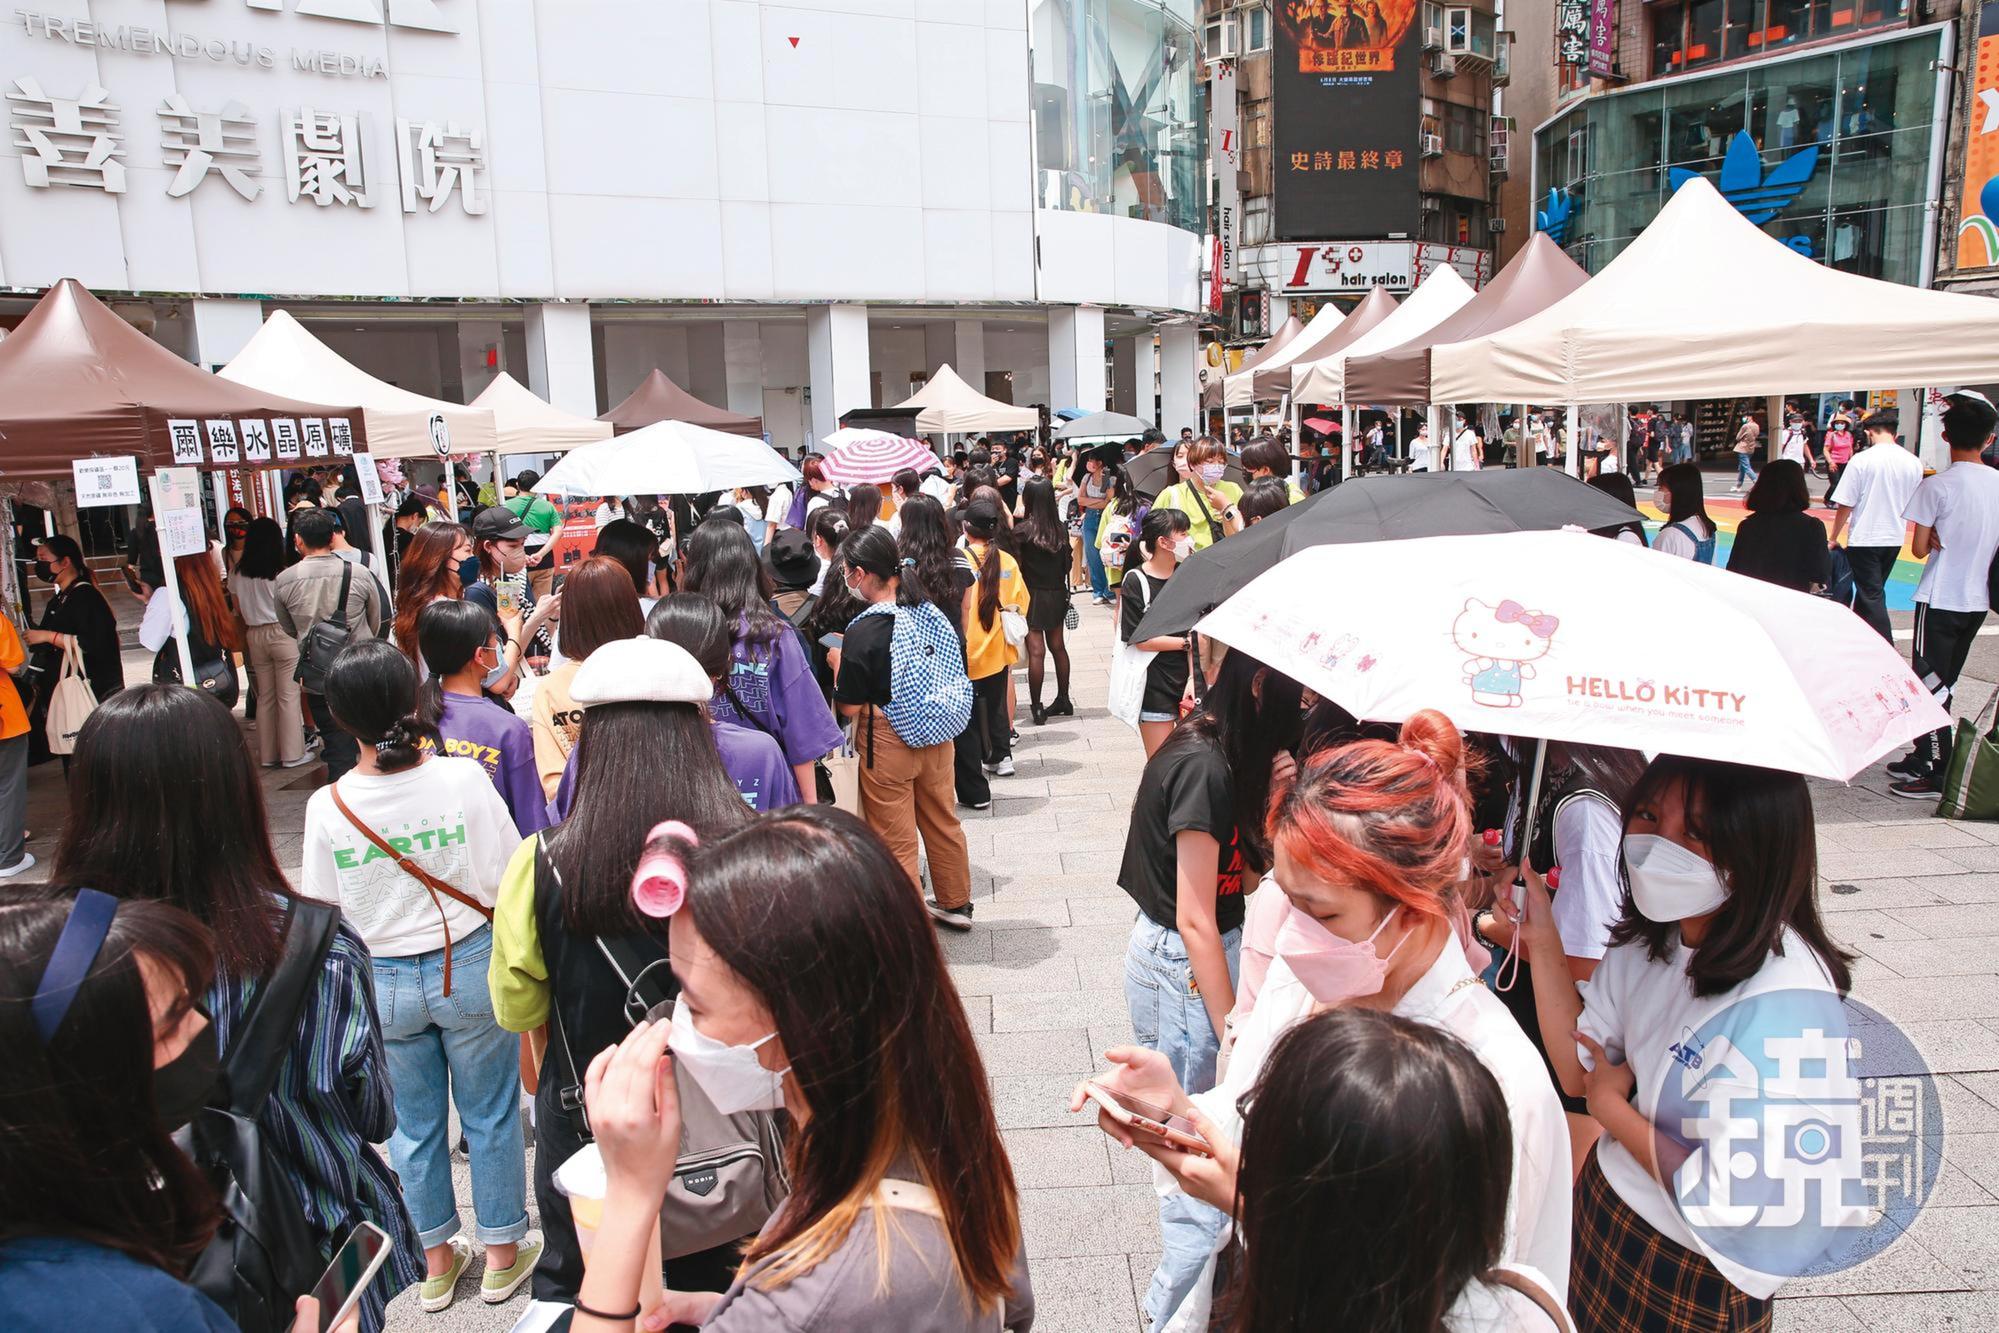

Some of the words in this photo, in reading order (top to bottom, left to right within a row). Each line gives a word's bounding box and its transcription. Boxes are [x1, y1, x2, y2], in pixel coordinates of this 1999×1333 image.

[15, 9, 275, 68] TREMENDOUS
[292, 48, 391, 80] MEDIA
[5, 75, 487, 215] 善美劇院
[1291, 151, 1403, 171] 史詩最終章
[1223, 207, 1232, 232] hair
[1223, 234, 1231, 270] salon
[1341, 273, 1366, 286] hair
[1371, 273, 1407, 286] salon
[173, 422, 352, 457] 爾樂水晶原礦
[1566, 676, 1655, 702] HELLO
[444, 738, 501, 764] BOYZ
[333, 824, 466, 870] EARTH
